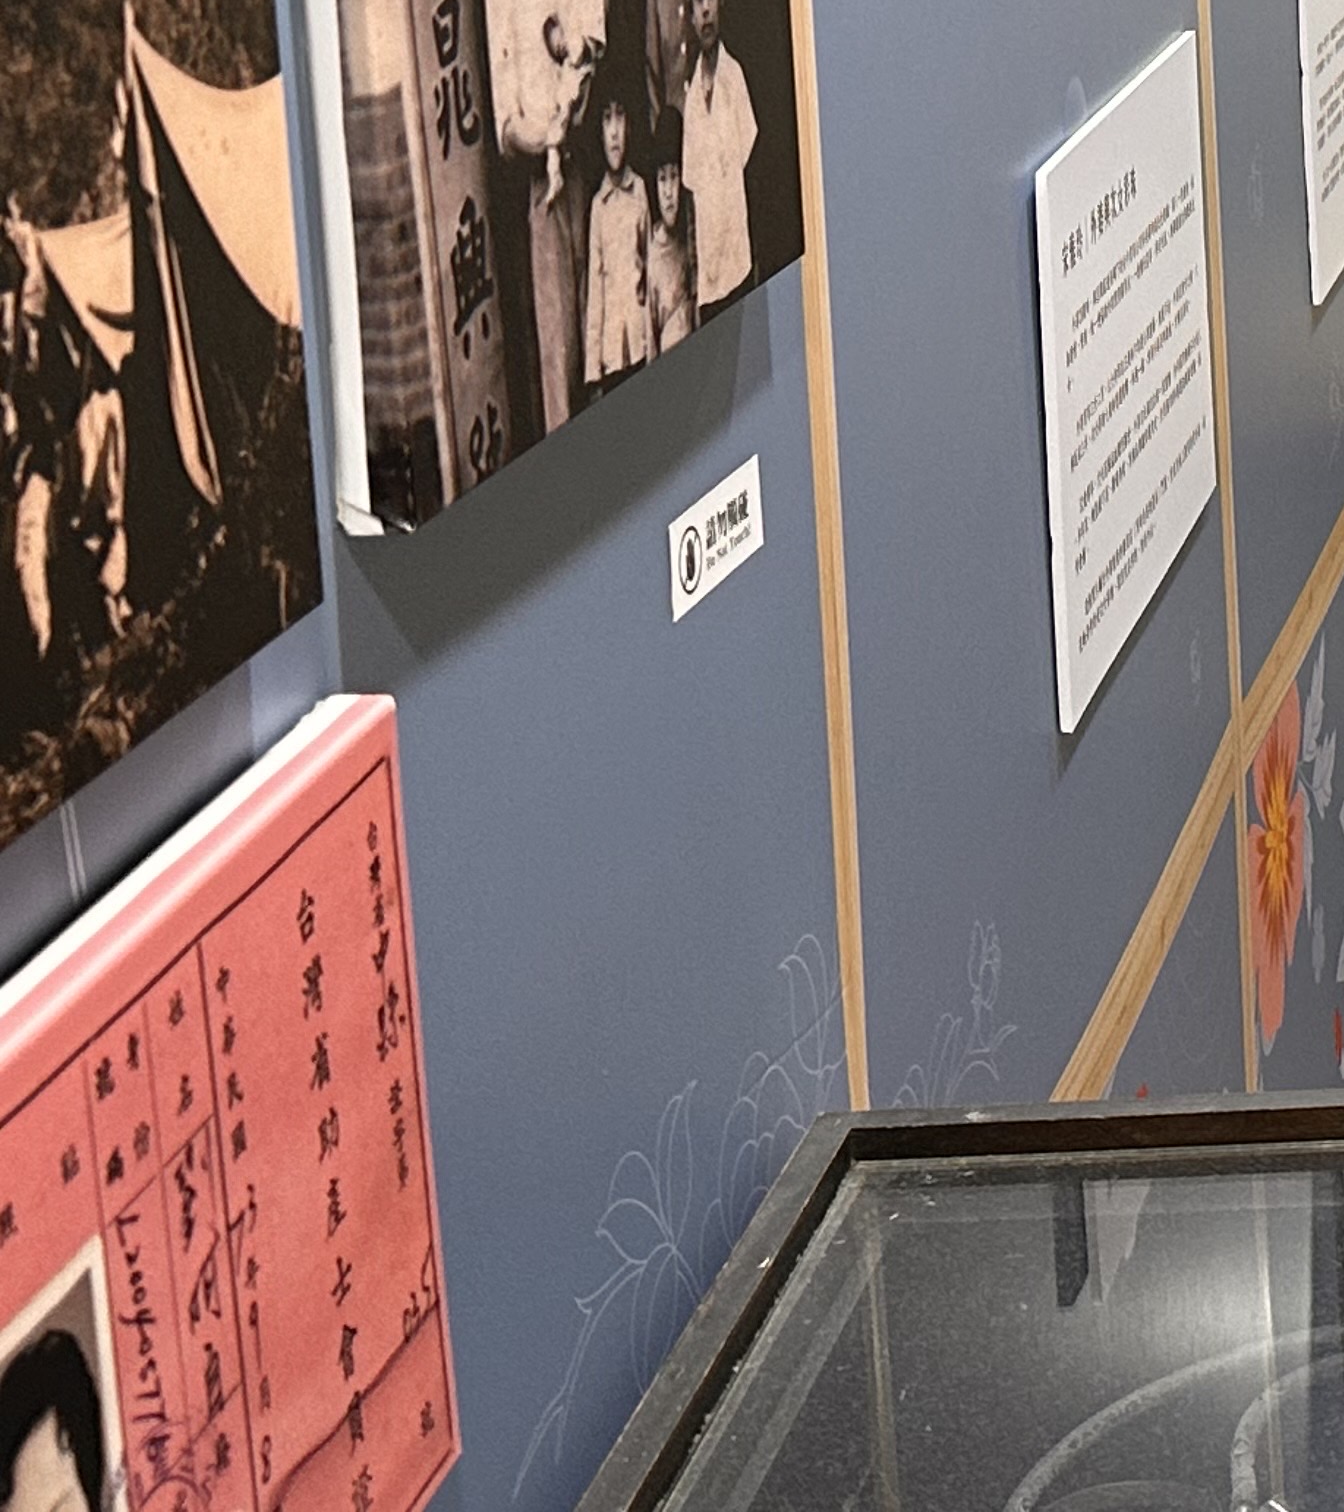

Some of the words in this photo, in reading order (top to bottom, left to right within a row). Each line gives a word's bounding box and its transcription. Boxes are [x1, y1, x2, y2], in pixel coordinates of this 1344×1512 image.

[296, 888, 374, 1512] 台灣省助產士會員證
